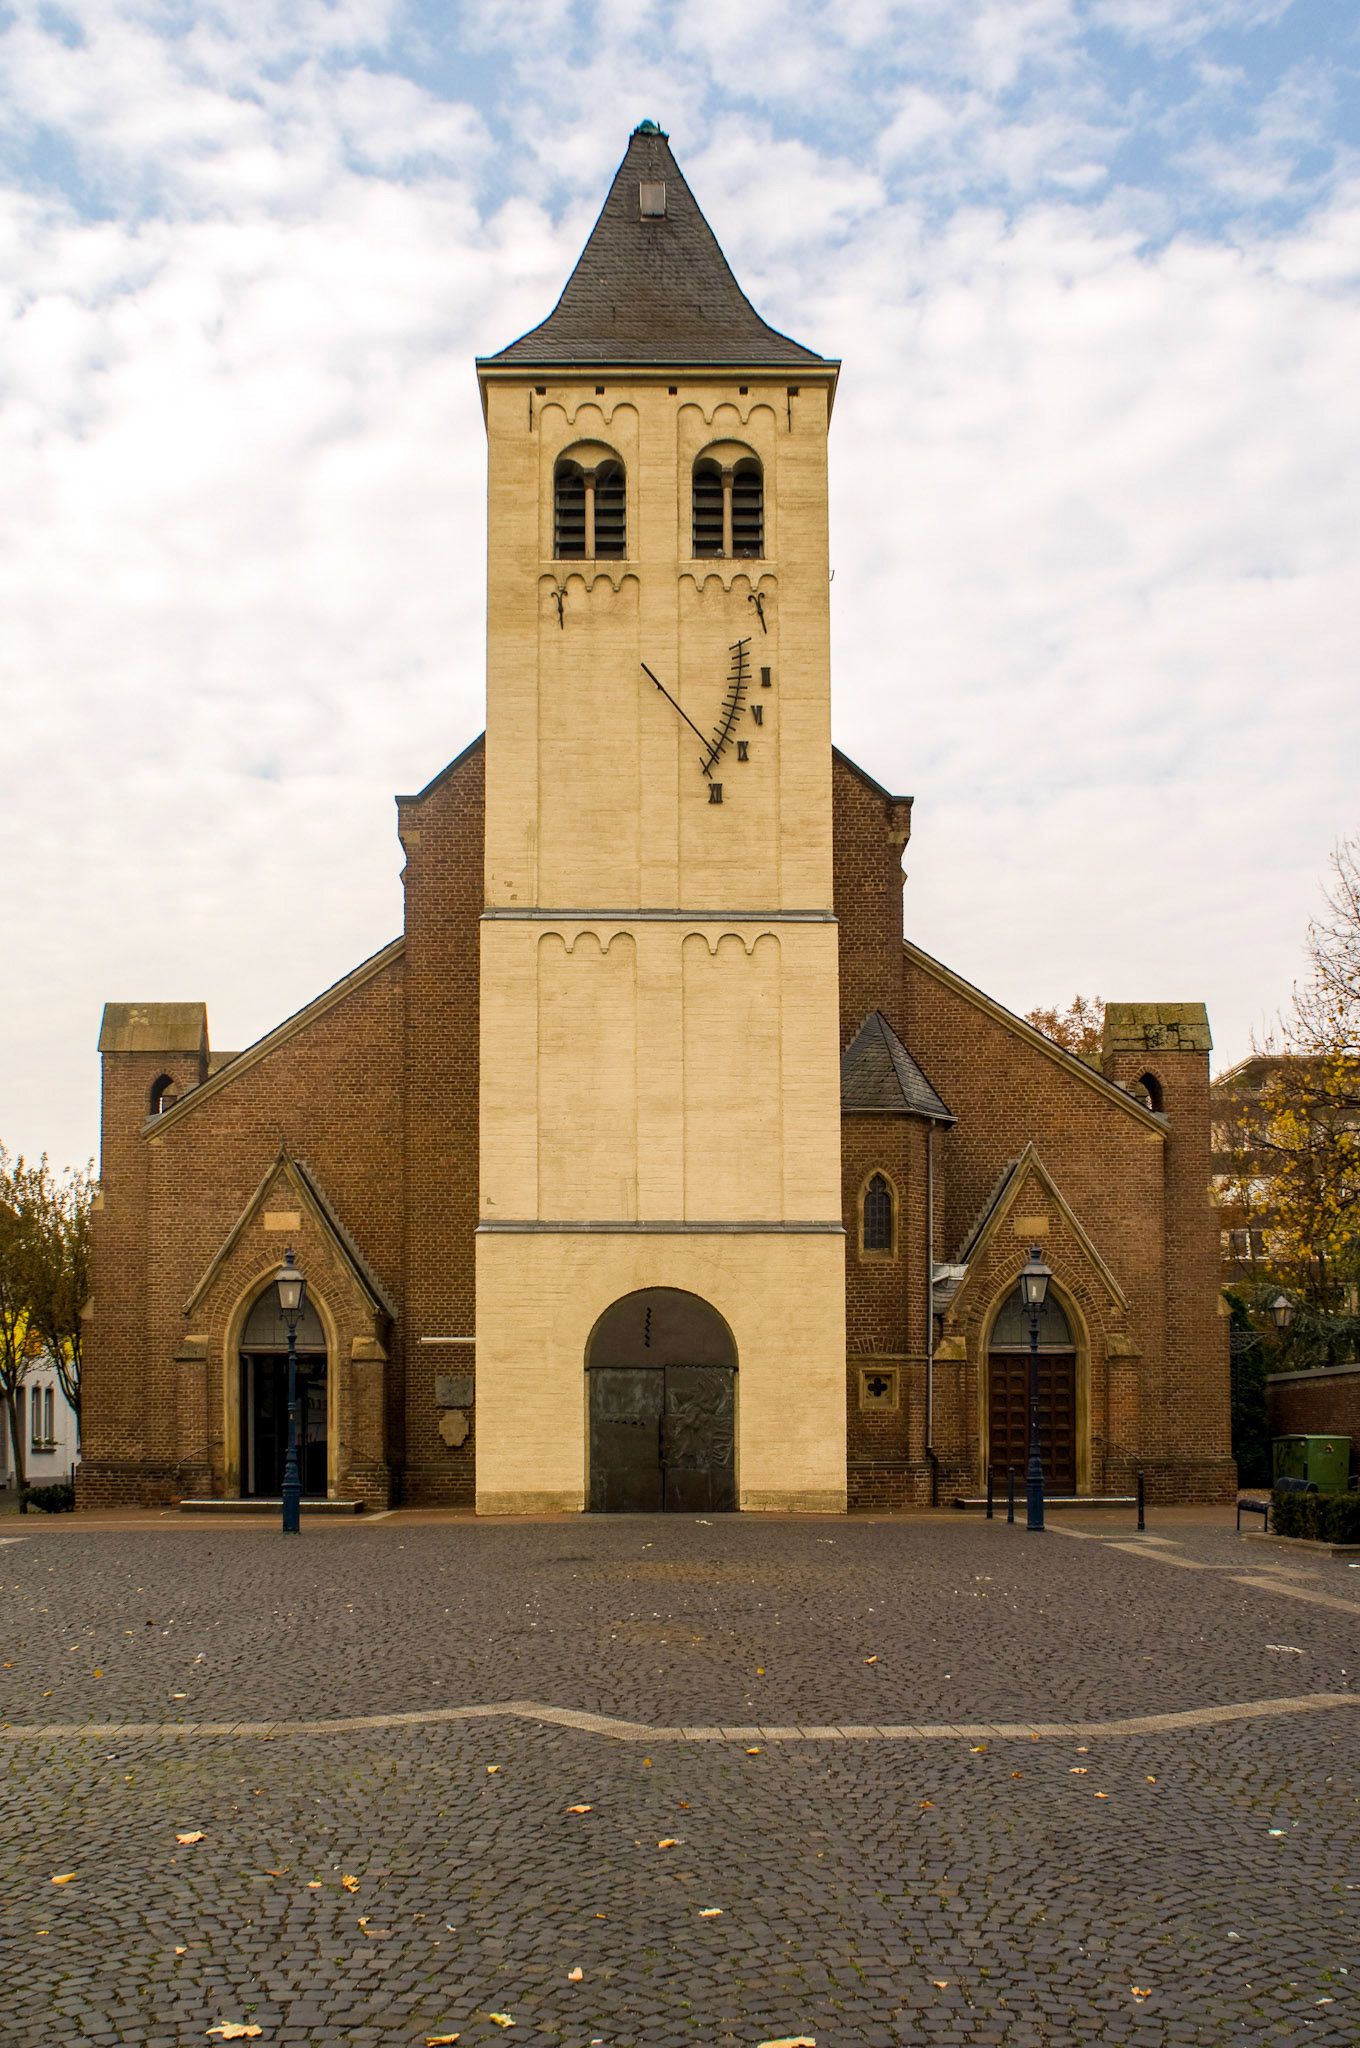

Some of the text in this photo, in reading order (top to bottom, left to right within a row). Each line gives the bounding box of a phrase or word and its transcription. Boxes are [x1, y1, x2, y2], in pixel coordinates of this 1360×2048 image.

[751, 705, 763, 726] VI
[737, 741, 749, 761] IX
[708, 783, 723, 804] XII
